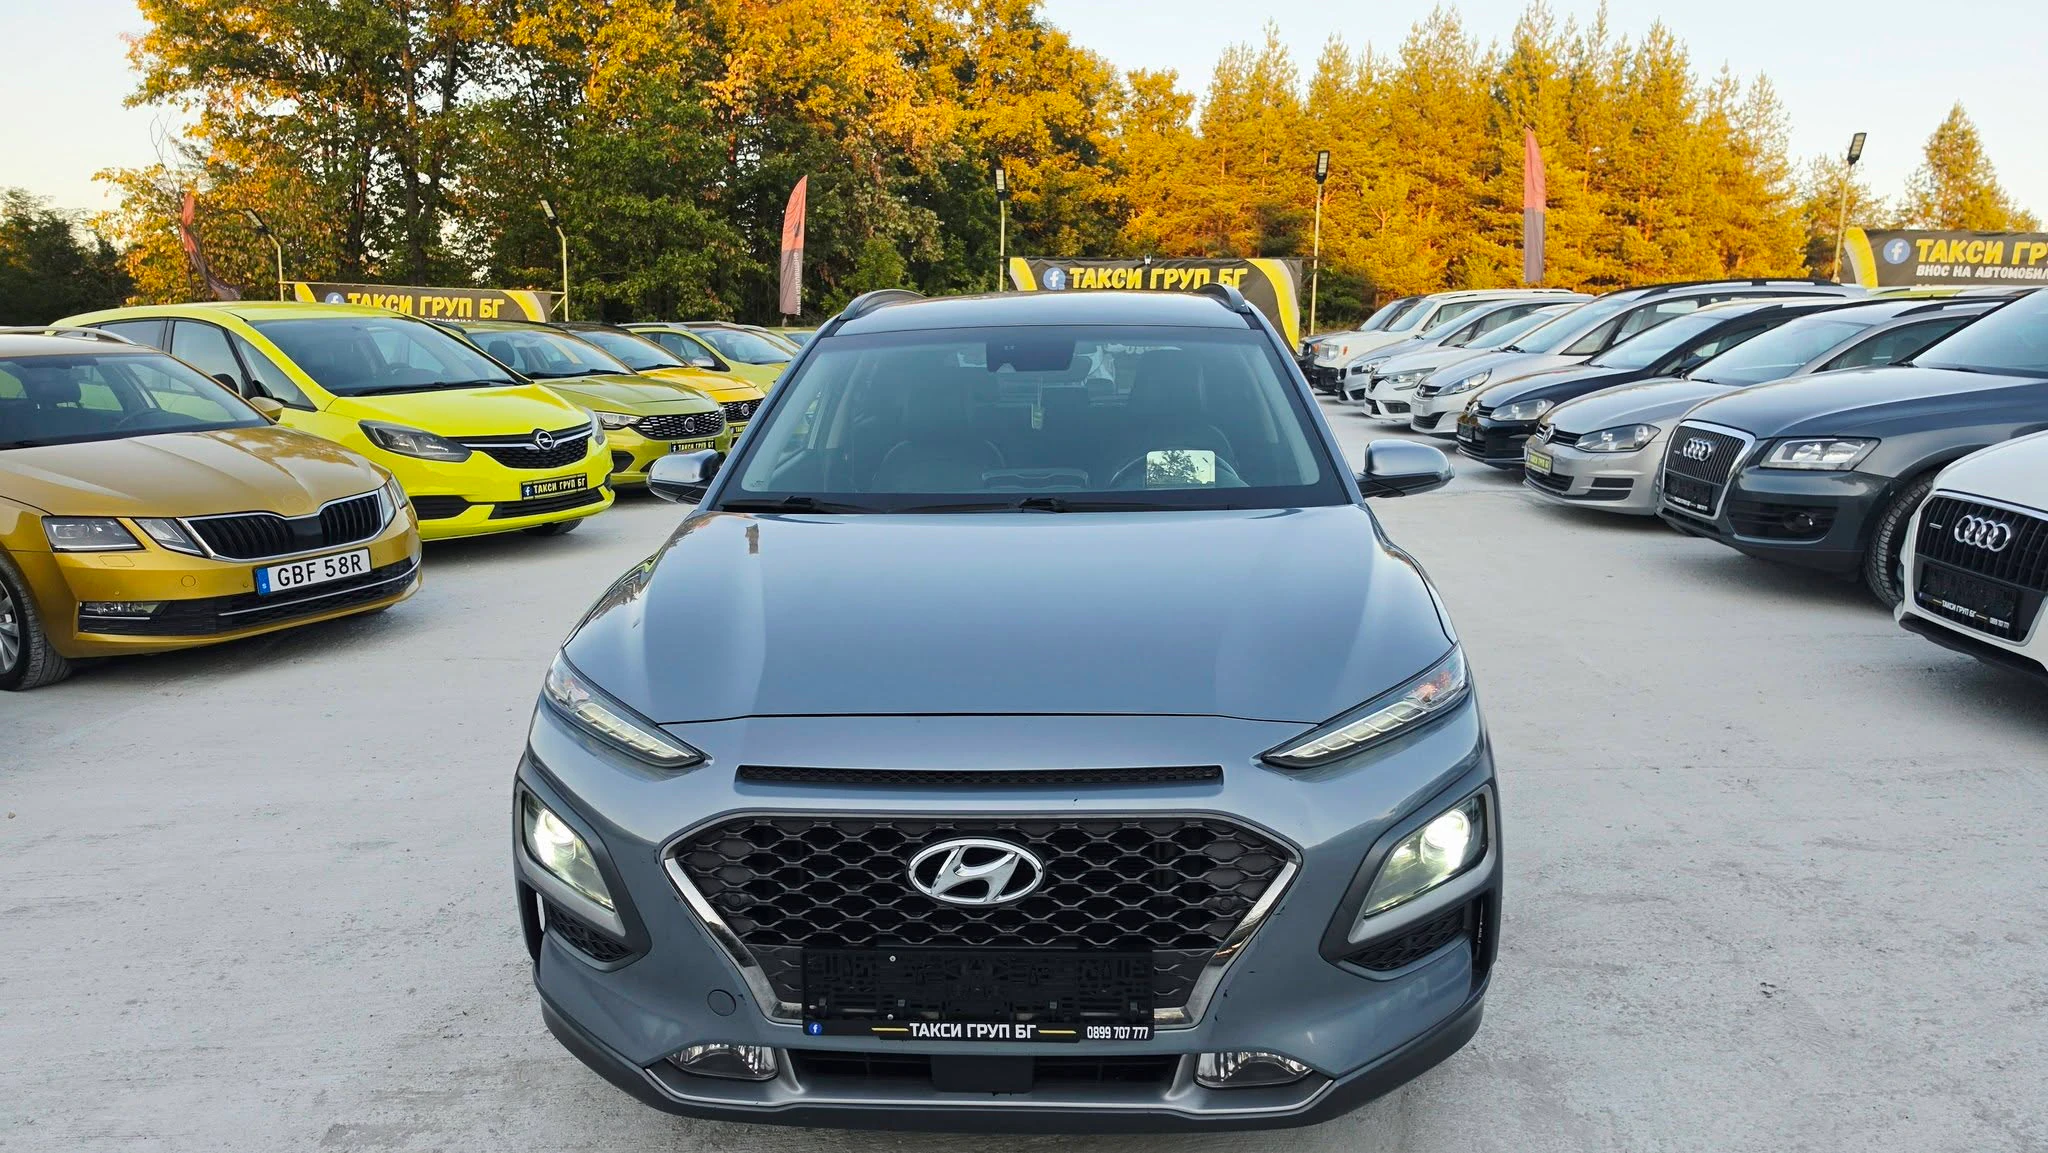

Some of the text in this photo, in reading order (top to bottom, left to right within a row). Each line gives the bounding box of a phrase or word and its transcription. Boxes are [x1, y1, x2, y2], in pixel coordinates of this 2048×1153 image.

[1915, 239, 2048, 265] ТАКСИ ГР
[1069, 267, 1248, 290] ТАКСИ ГРУП БГ
[1916, 265, 1950, 277] ВНОС
[1952, 265, 1971, 278] НА
[347, 292, 505, 319] ТАКСИ ГРУП БГ
[533, 477, 586, 494] ТАКСИ ГРУП БГ
[277, 554, 362, 587] GBF 58R
[909, 1022, 1036, 1040] ТАКСИ ГРУП БГ
[1087, 1026, 1149, 1040] 0899 707 777
